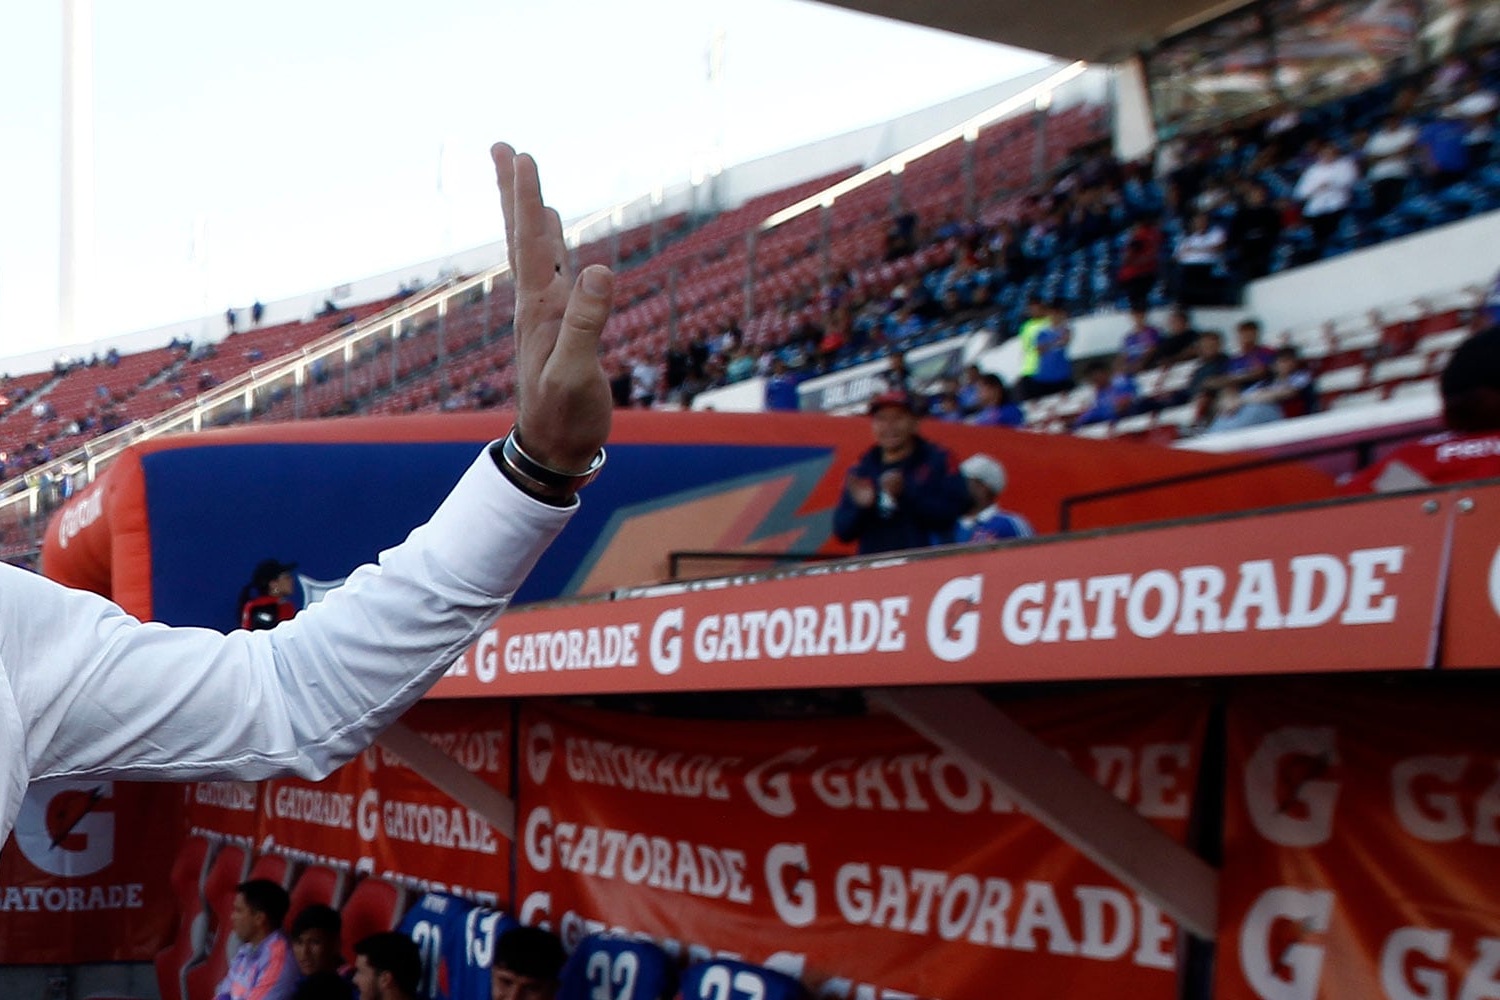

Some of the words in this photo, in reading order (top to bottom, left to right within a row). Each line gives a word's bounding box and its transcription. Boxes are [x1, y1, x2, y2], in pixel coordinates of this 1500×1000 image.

[475, 629, 498, 684] G
[504, 622, 640, 673] GATORADE
[650, 607, 684, 675] G
[694, 596, 909, 663] GATORADE
[926, 574, 983, 662] G
[1002, 546, 1404, 645] GATORADE
[14, 779, 116, 878] G
[357, 788, 380, 842] G
[564, 737, 744, 801] GATORADE
[743, 745, 819, 818] G
[811, 742, 1191, 819] GATODE
[1242, 724, 1342, 847] G
[524, 806, 553, 873] G
[555, 822, 754, 906] GATORADE
[764, 841, 818, 928] G
[835, 862, 1177, 971] GATORADE
